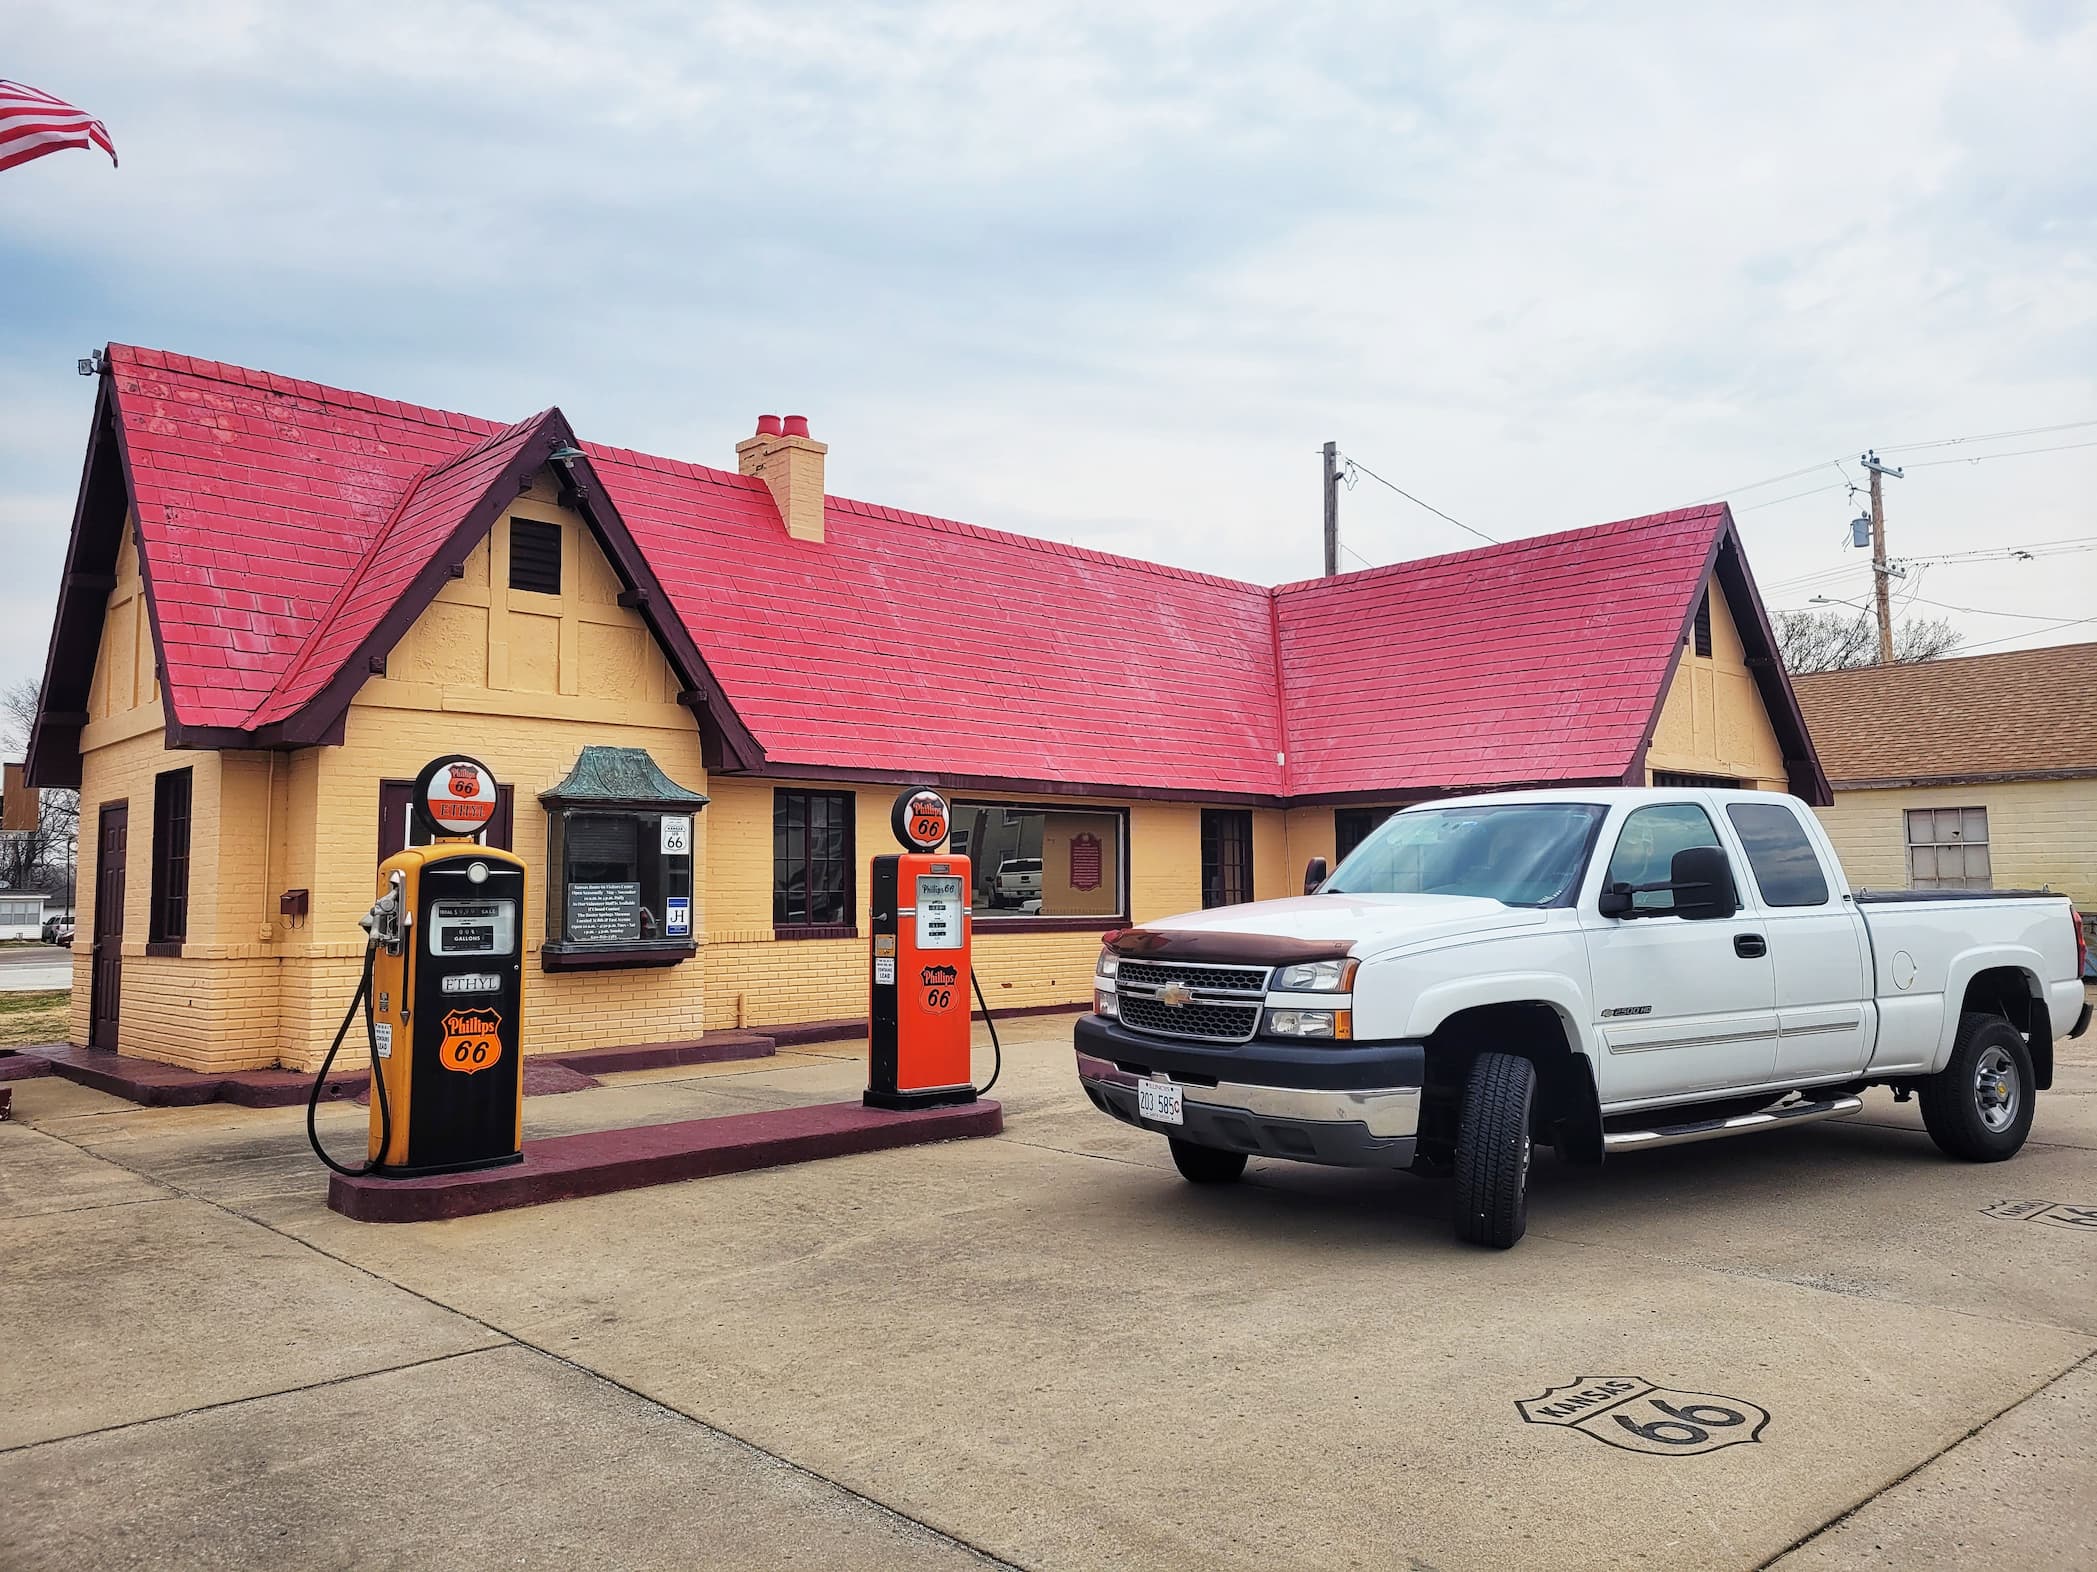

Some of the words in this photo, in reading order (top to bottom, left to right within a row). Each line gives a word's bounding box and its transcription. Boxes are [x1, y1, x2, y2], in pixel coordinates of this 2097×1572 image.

[455, 781, 474, 794] 66
[440, 804, 486, 817] ETHYL
[913, 802, 942, 817] Phillips
[918, 819, 939, 836] 66
[667, 836, 683, 848] 66
[922, 884, 944, 895] Phillips
[944, 885, 955, 893] 66
[446, 977, 497, 990] ETHYL
[923, 970, 954, 986] Phillips
[928, 989, 951, 1008] 66
[1614, 1007, 1640, 1016] 2500
[448, 1017, 495, 1037] Phillips
[454, 1040, 490, 1063] 66
[1140, 1091, 1154, 1111] 203
[1536, 1380, 1636, 1418] KANSAS
[1612, 1399, 1747, 1445] 66
